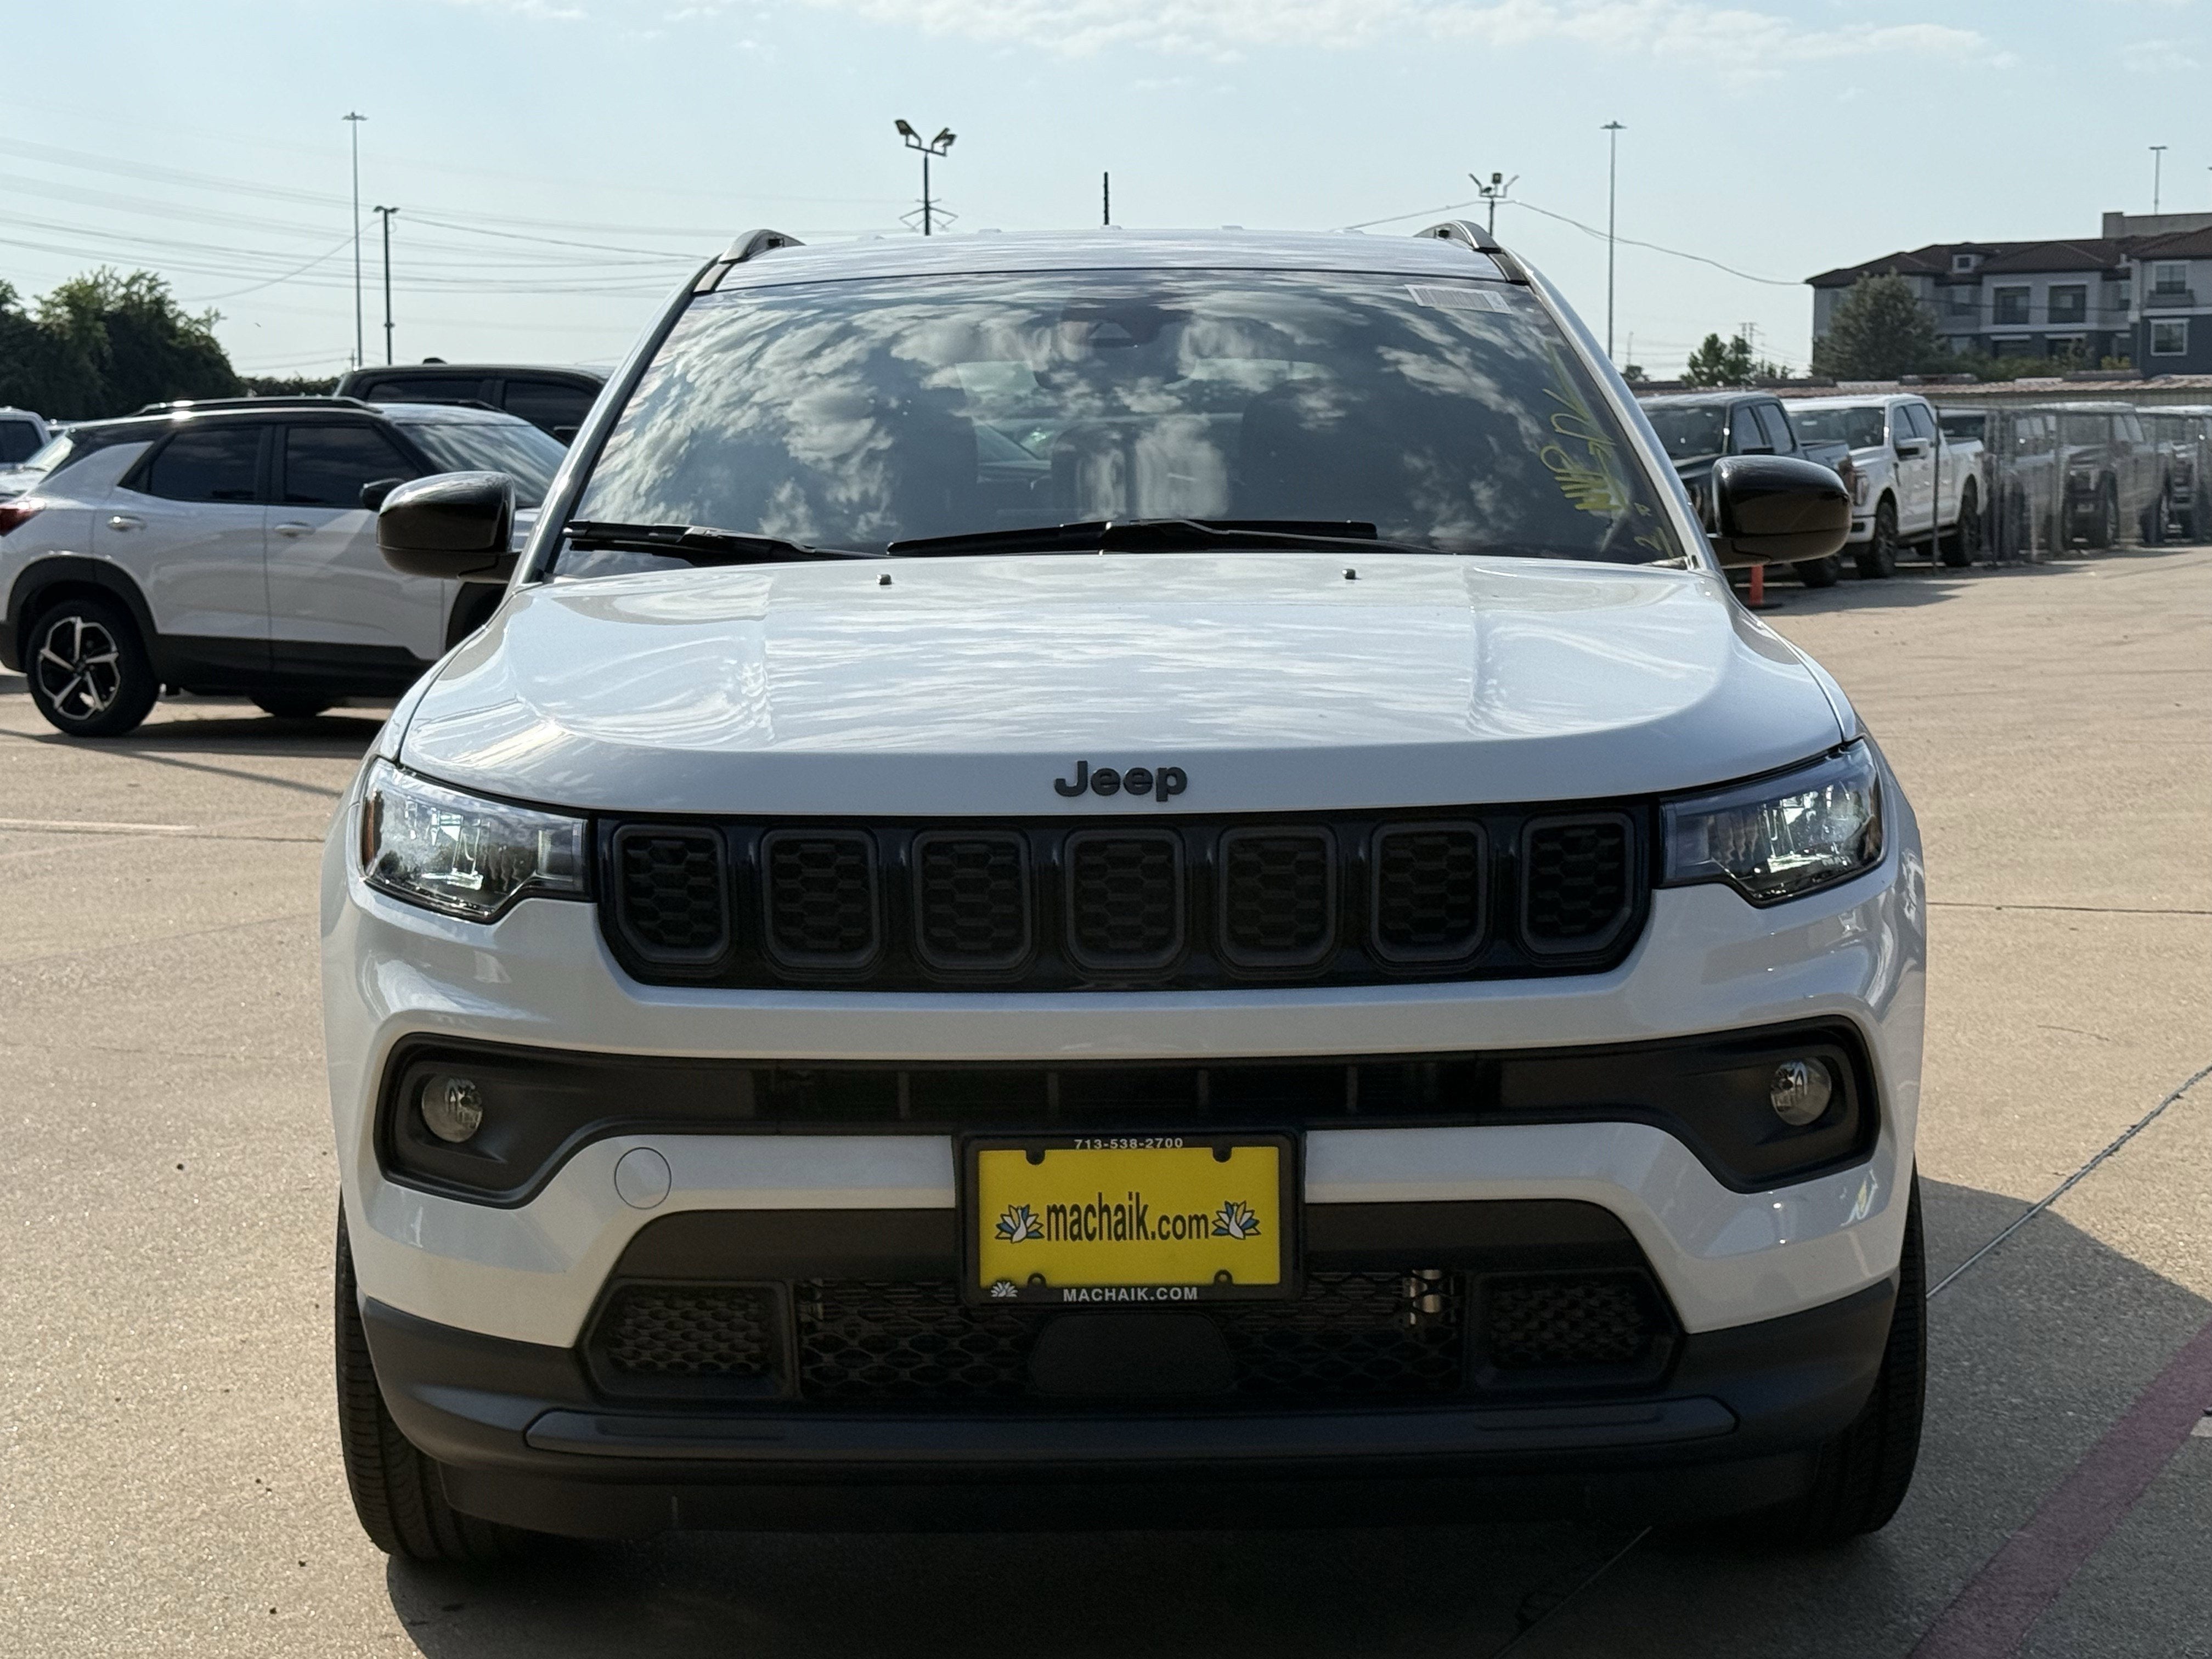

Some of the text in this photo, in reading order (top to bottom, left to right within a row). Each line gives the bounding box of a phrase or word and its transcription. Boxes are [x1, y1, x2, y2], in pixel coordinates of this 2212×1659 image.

[1054, 760, 1187, 802] Jeep
[1074, 1138, 1183, 1149] 713-538-2700
[1046, 1192, 1209, 1242] machaik.com
[1063, 1286, 1198, 1302] MACHAIK.COM
